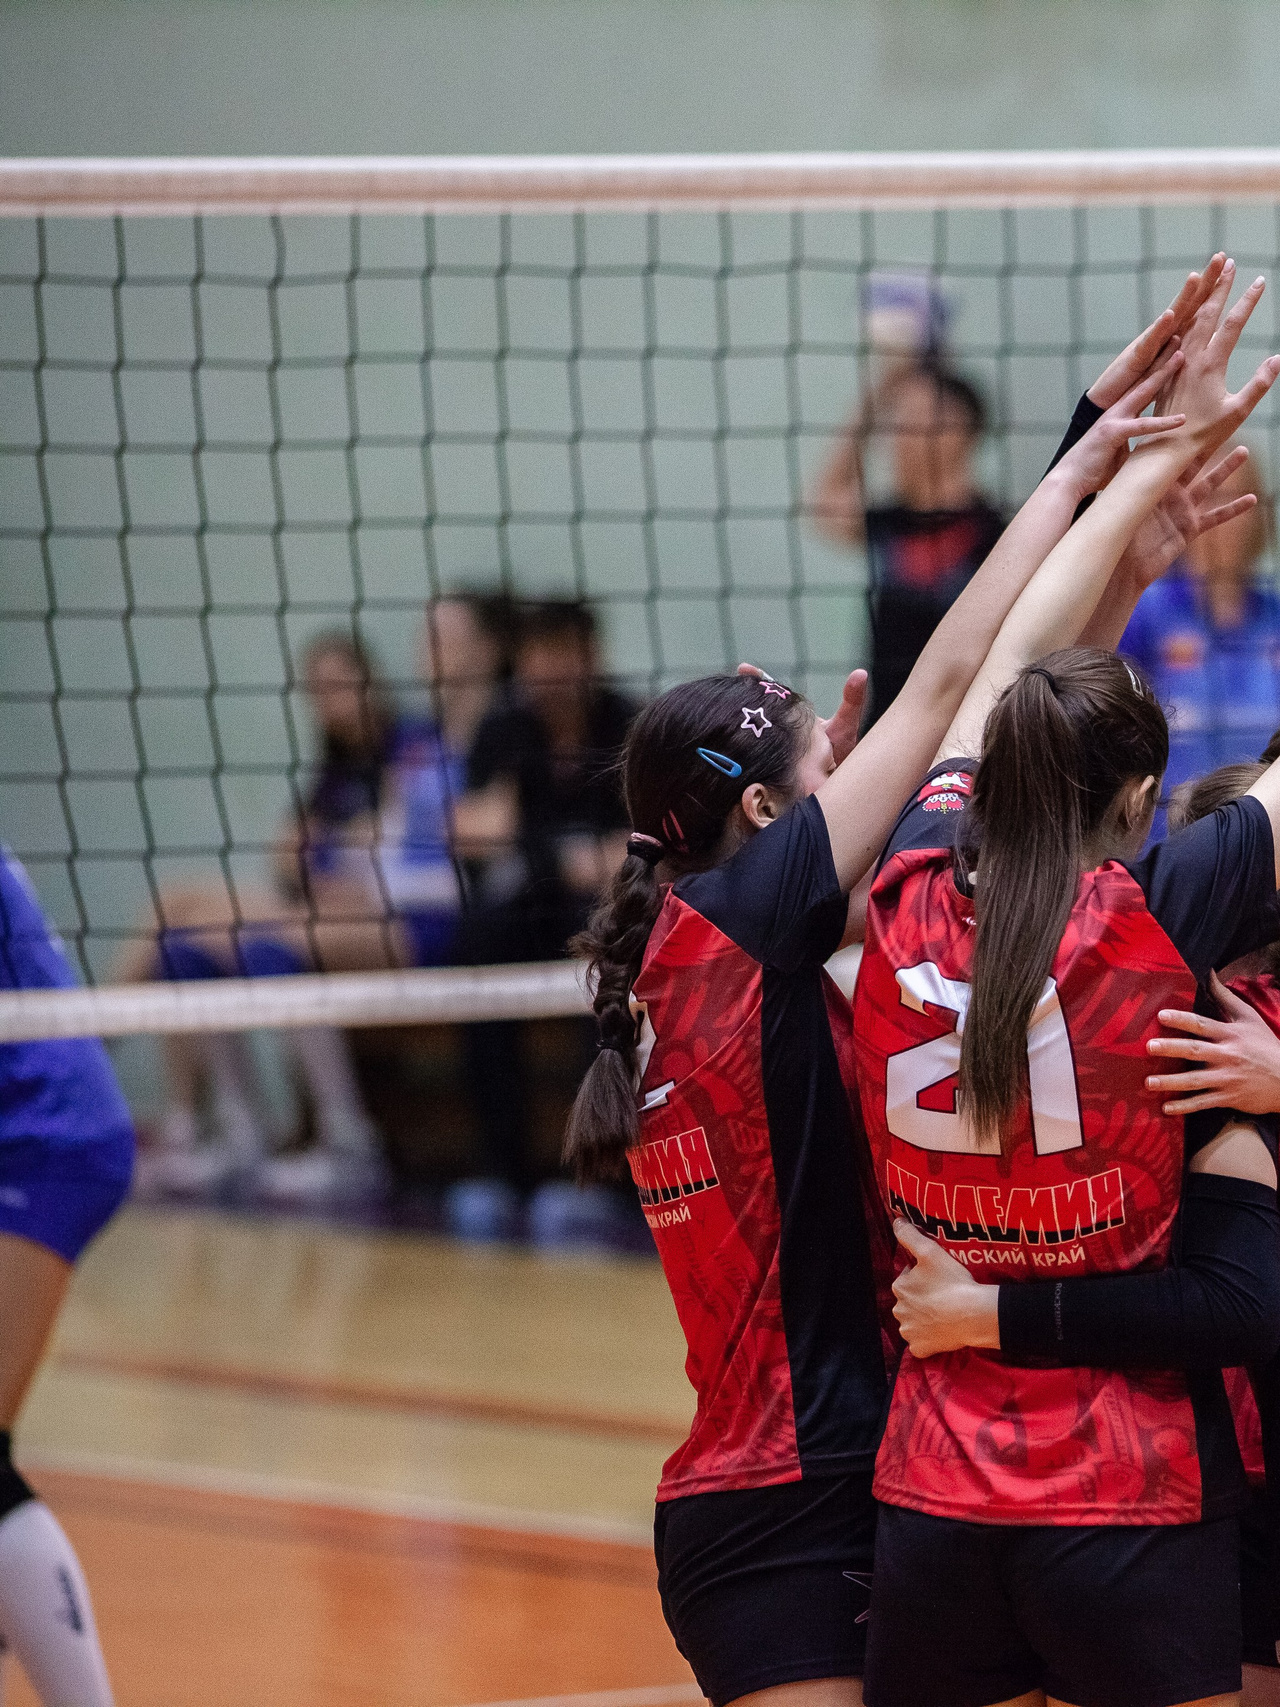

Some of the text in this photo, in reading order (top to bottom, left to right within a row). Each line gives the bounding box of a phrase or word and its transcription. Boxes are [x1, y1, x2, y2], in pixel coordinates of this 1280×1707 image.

[886, 961, 1084, 1156] 21
[657, 1202, 693, 1229] КРАЙ
[949, 1243, 1087, 1267] МСКИЙ КРАЙ
